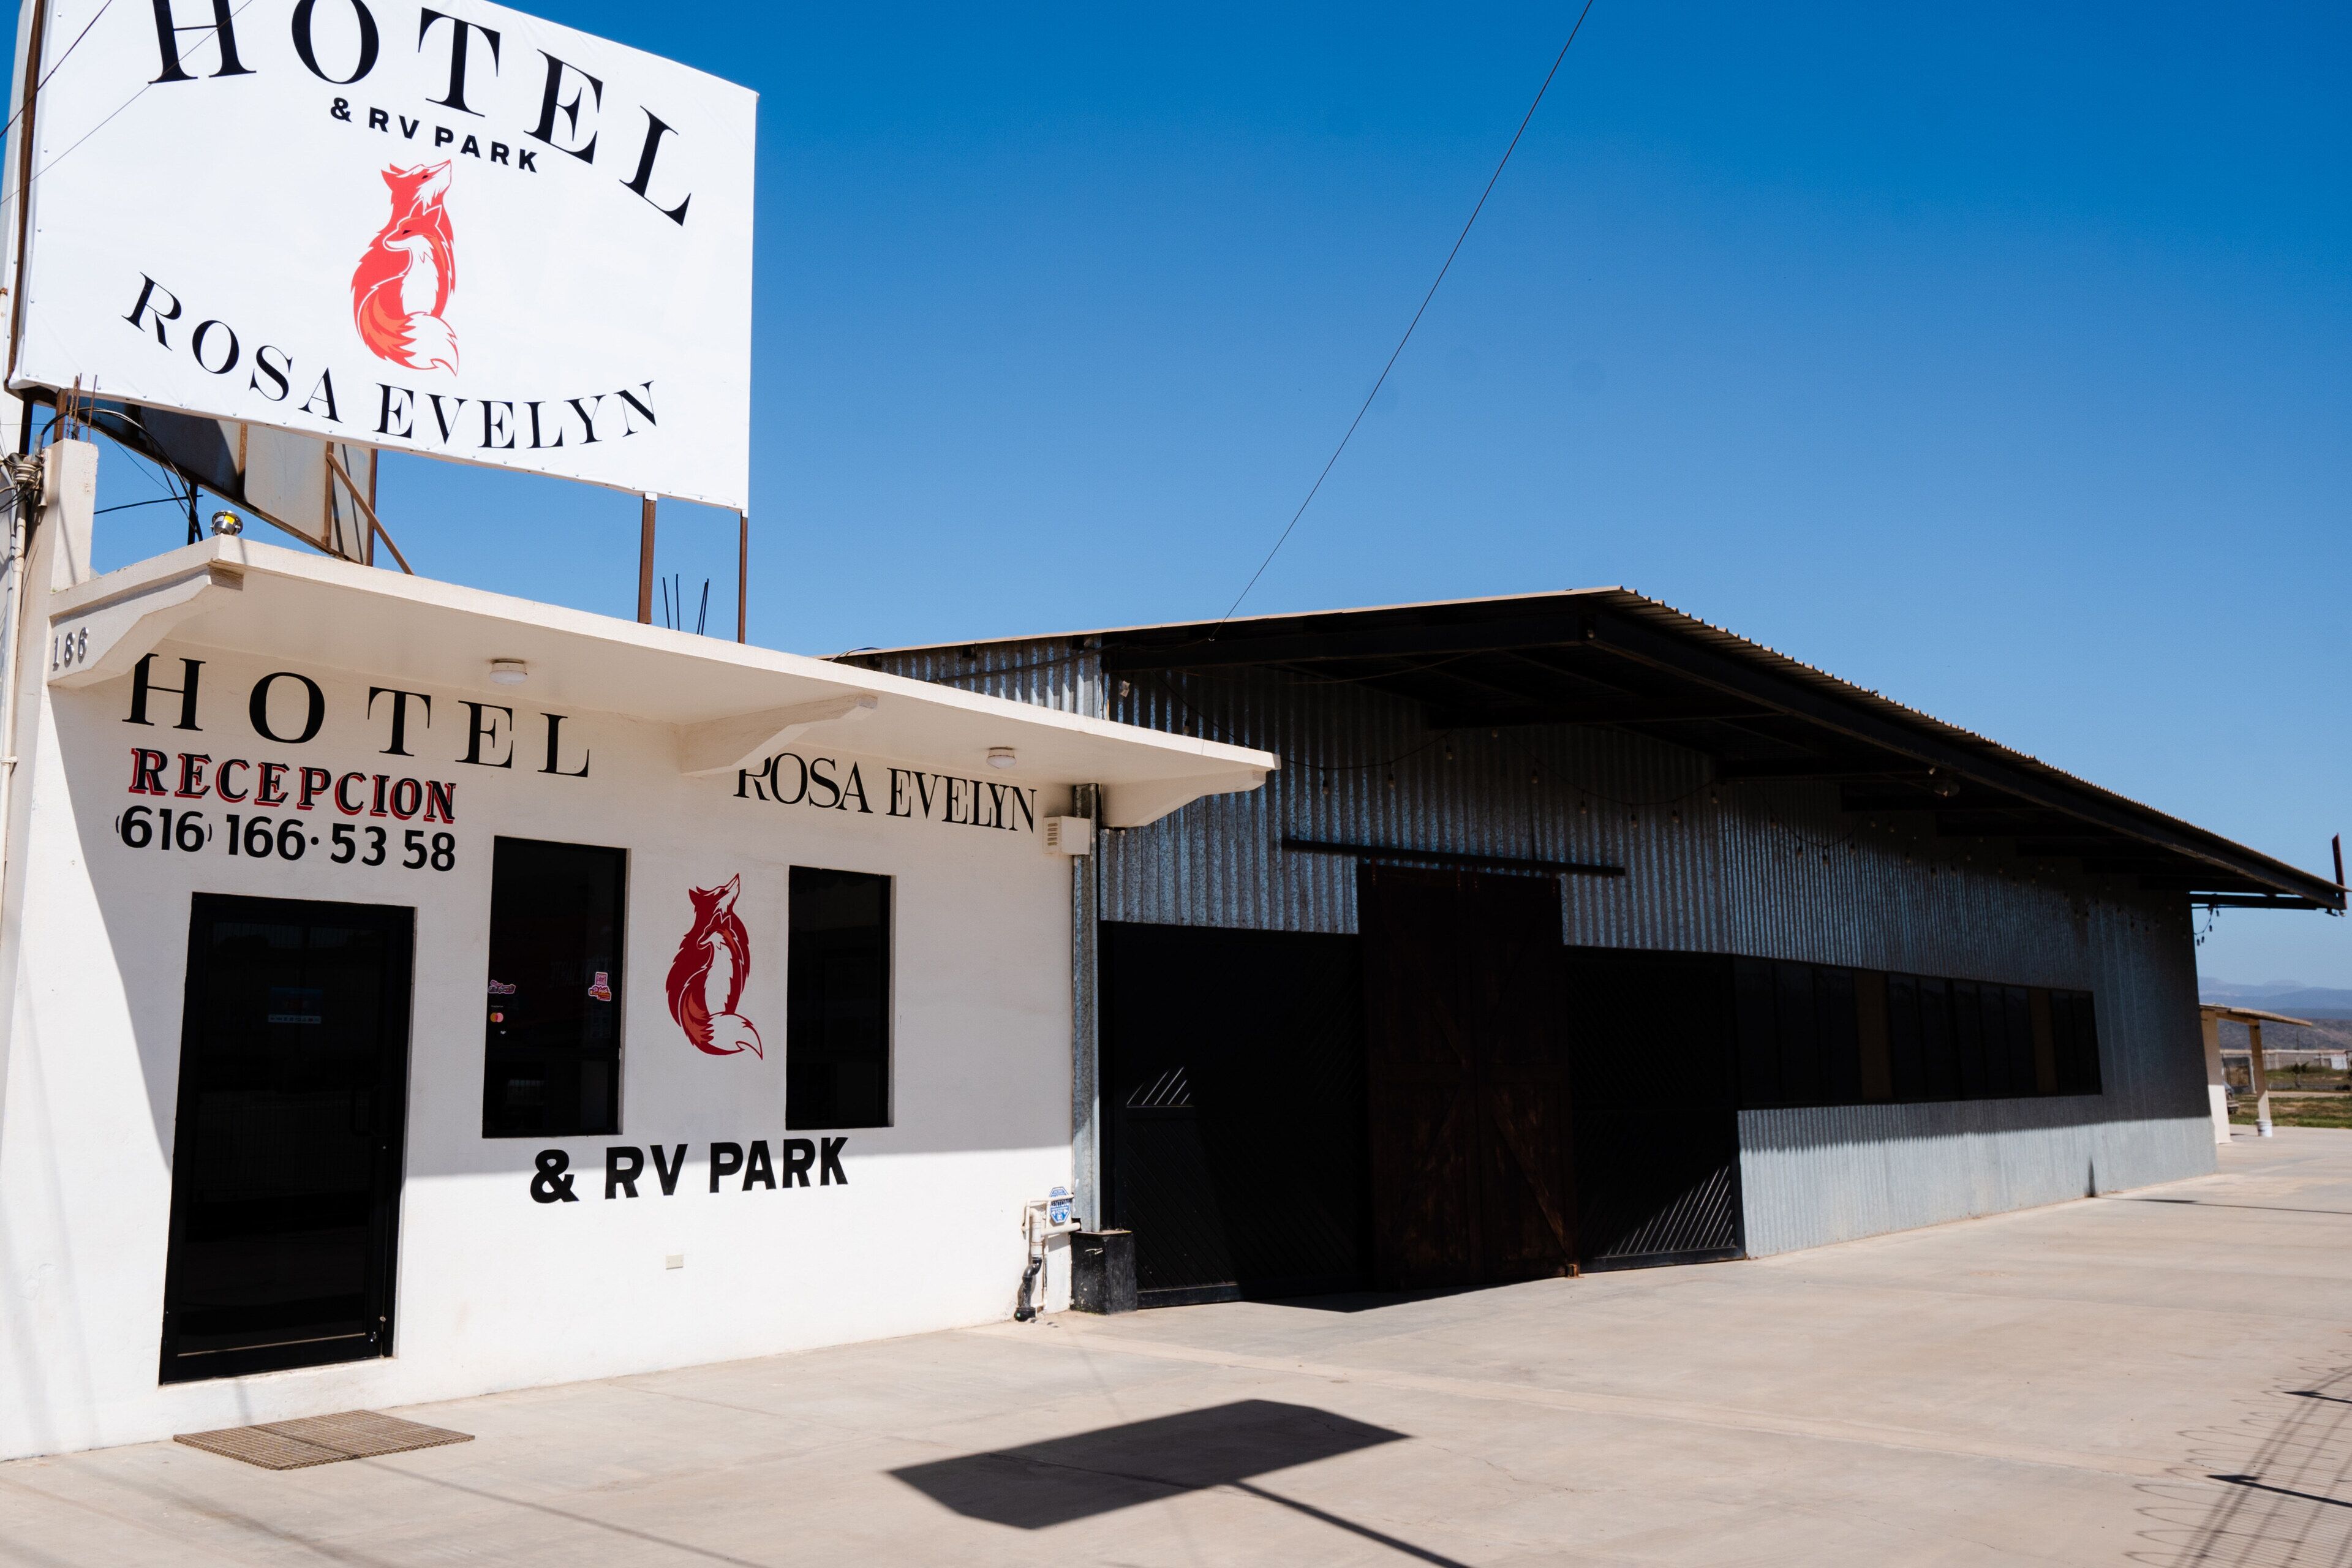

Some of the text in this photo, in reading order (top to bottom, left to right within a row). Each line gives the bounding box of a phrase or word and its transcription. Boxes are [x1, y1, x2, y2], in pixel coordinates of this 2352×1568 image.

[148, 0, 692, 226] HOTEL
[330, 97, 537, 173] & RV PARK
[123, 271, 657, 449] ROSA EVELYN
[53, 627, 88, 670] 186
[122, 653, 590, 778] HOTEL
[128, 748, 456, 824] RECEPCION
[733, 753, 1036, 833] ROSA EVELYN
[530, 1137, 848, 1203] & RV PARK
